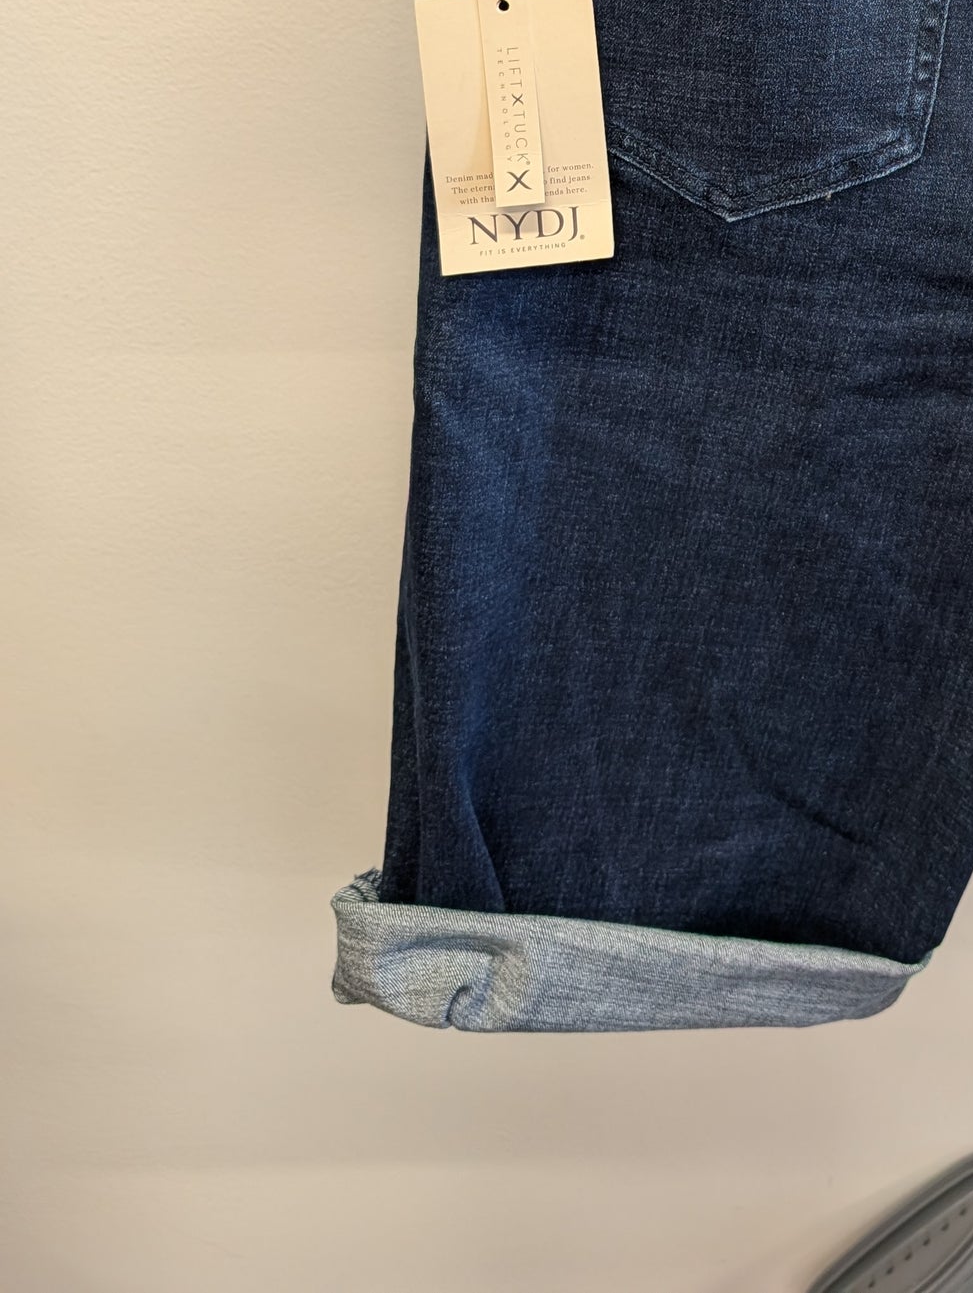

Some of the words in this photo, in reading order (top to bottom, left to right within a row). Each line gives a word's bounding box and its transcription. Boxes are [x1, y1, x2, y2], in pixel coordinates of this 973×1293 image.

[445, 174, 474, 184] Denim
[476, 172, 494, 181] mad
[547, 165, 560, 174] for
[562, 163, 594, 172] women.
[451, 186, 468, 195] The
[549, 175, 567, 185] find
[568, 175, 591, 186] jeans
[459, 196, 478, 206] with
[566, 186, 588, 195] here.
[479, 249, 493, 257] FIT
[497, 247, 507, 255] IS
[510, 242, 567, 254] EVERYTHING
